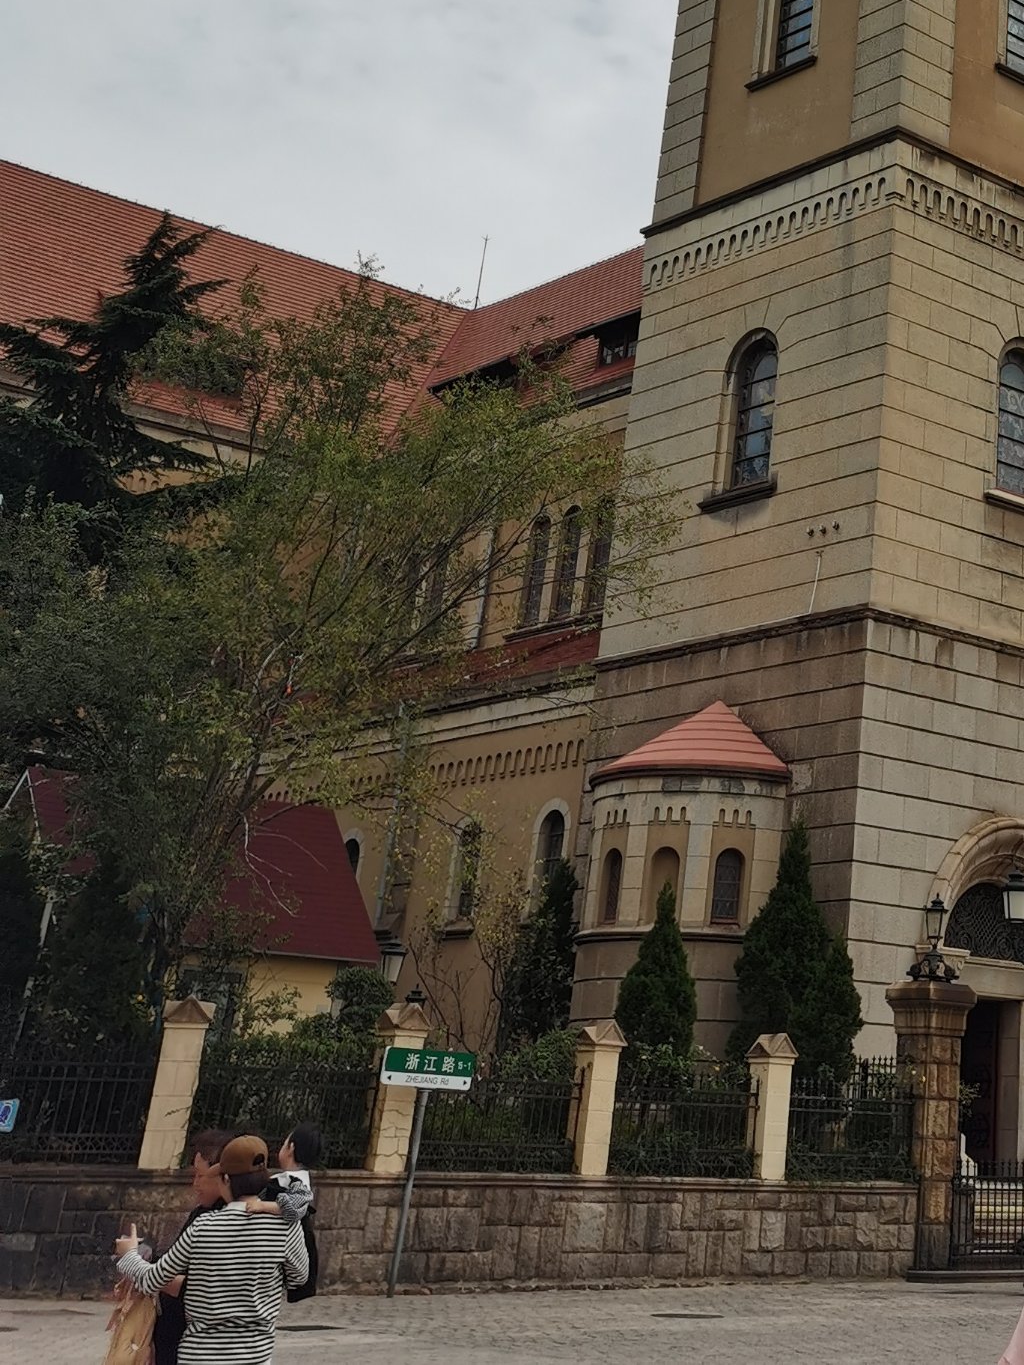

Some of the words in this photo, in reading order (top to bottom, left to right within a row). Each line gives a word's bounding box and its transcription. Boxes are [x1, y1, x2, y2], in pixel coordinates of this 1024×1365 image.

[405, 1053, 455, 1073] 浙江路
[405, 1075, 438, 1084] ZHEJIANG
[440, 1077, 449, 1085] Rd
